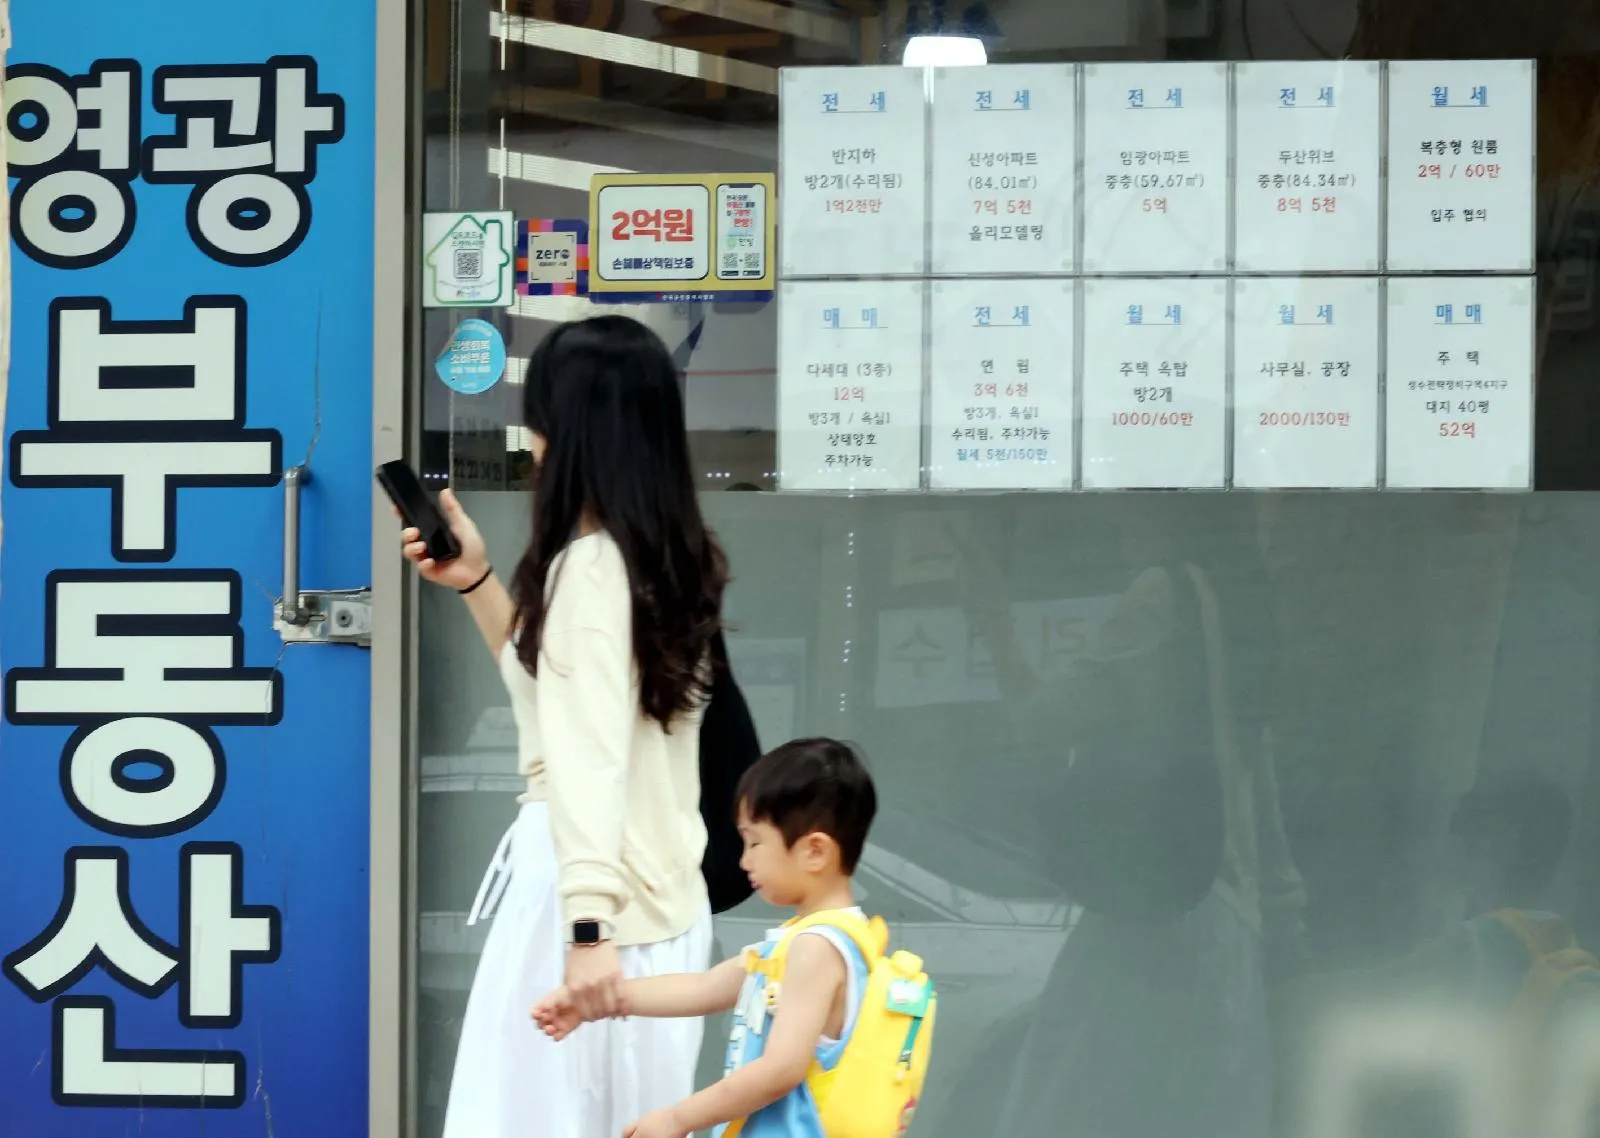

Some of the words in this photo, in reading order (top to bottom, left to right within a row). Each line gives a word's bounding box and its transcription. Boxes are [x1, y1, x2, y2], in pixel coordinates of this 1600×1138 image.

[822, 93, 838, 111] 전
[870, 92, 886, 110] 세
[976, 91, 992, 109] 전
[1014, 90, 1030, 109] 세
[1128, 88, 1144, 107] 전
[1166, 88, 1182, 106] 세
[1280, 88, 1296, 106] 전
[1317, 87, 1334, 106] 세
[1432, 86, 1448, 106] 월
[1470, 86, 1488, 105] 세
[1421, 140, 1462, 155] 복층형
[1472, 140, 1498, 154] 원룸
[5, 55, 346, 269] 영광
[832, 149, 876, 165] 반지하
[968, 152, 1038, 167] 신성아파트
[1120, 150, 1191, 166] 임광아파트
[1279, 150, 1335, 164] 두산위브
[1418, 165, 1441, 179] 2억
[1465, 164, 1501, 179] 60만
[804, 174, 902, 190] 방2개(수리됨)
[826, 199, 882, 214] 1억2천만
[974, 200, 997, 215] 7억
[1007, 200, 1032, 215] 5천
[1142, 198, 1167, 214] 5억
[1278, 198, 1302, 213] 8억
[1312, 198, 1336, 214] 5천
[1431, 209, 1454, 222] 입주
[1463, 209, 1487, 222] 협의
[611, 208, 695, 242] 2억원
[968, 225, 1044, 242] 올리모델링
[536, 248, 570, 260] zero
[612, 257, 695, 271] 손해배상책임보증
[824, 308, 840, 327] 매
[862, 308, 878, 326] 매
[974, 306, 990, 325] 전
[1012, 306, 1029, 324] 세
[1126, 305, 1142, 324] 월
[1164, 305, 1181, 324] 세
[1279, 305, 1295, 324] 월
[1317, 304, 1333, 324] 세
[1436, 304, 1452, 323] 매
[1466, 304, 1481, 322] 매
[1437, 352, 1450, 365] 주
[1467, 351, 1479, 365] 택
[807, 364, 848, 376] 다세대
[981, 360, 994, 374] 연
[1120, 362, 1148, 376] 주택
[1158, 362, 1188, 376] 옥탑
[1321, 362, 1350, 377] 공장
[834, 388, 864, 402] 12억
[974, 384, 997, 397] 3억
[1006, 382, 1028, 397] 6천
[1134, 387, 1172, 402] 방2개
[1426, 401, 1450, 414] 대지
[1458, 401, 1489, 413] 40평
[808, 412, 840, 425] 방3개
[1112, 412, 1194, 427] 1000/60만
[1260, 412, 1350, 427] 2000/130만
[1002, 428, 1050, 440] 주차가능
[1439, 422, 1475, 438] 52억
[828, 433, 878, 445] 상태양호
[824, 455, 873, 466] 주차가능
[957, 448, 980, 461] 월세
[5, 294, 284, 1109] 부동산
